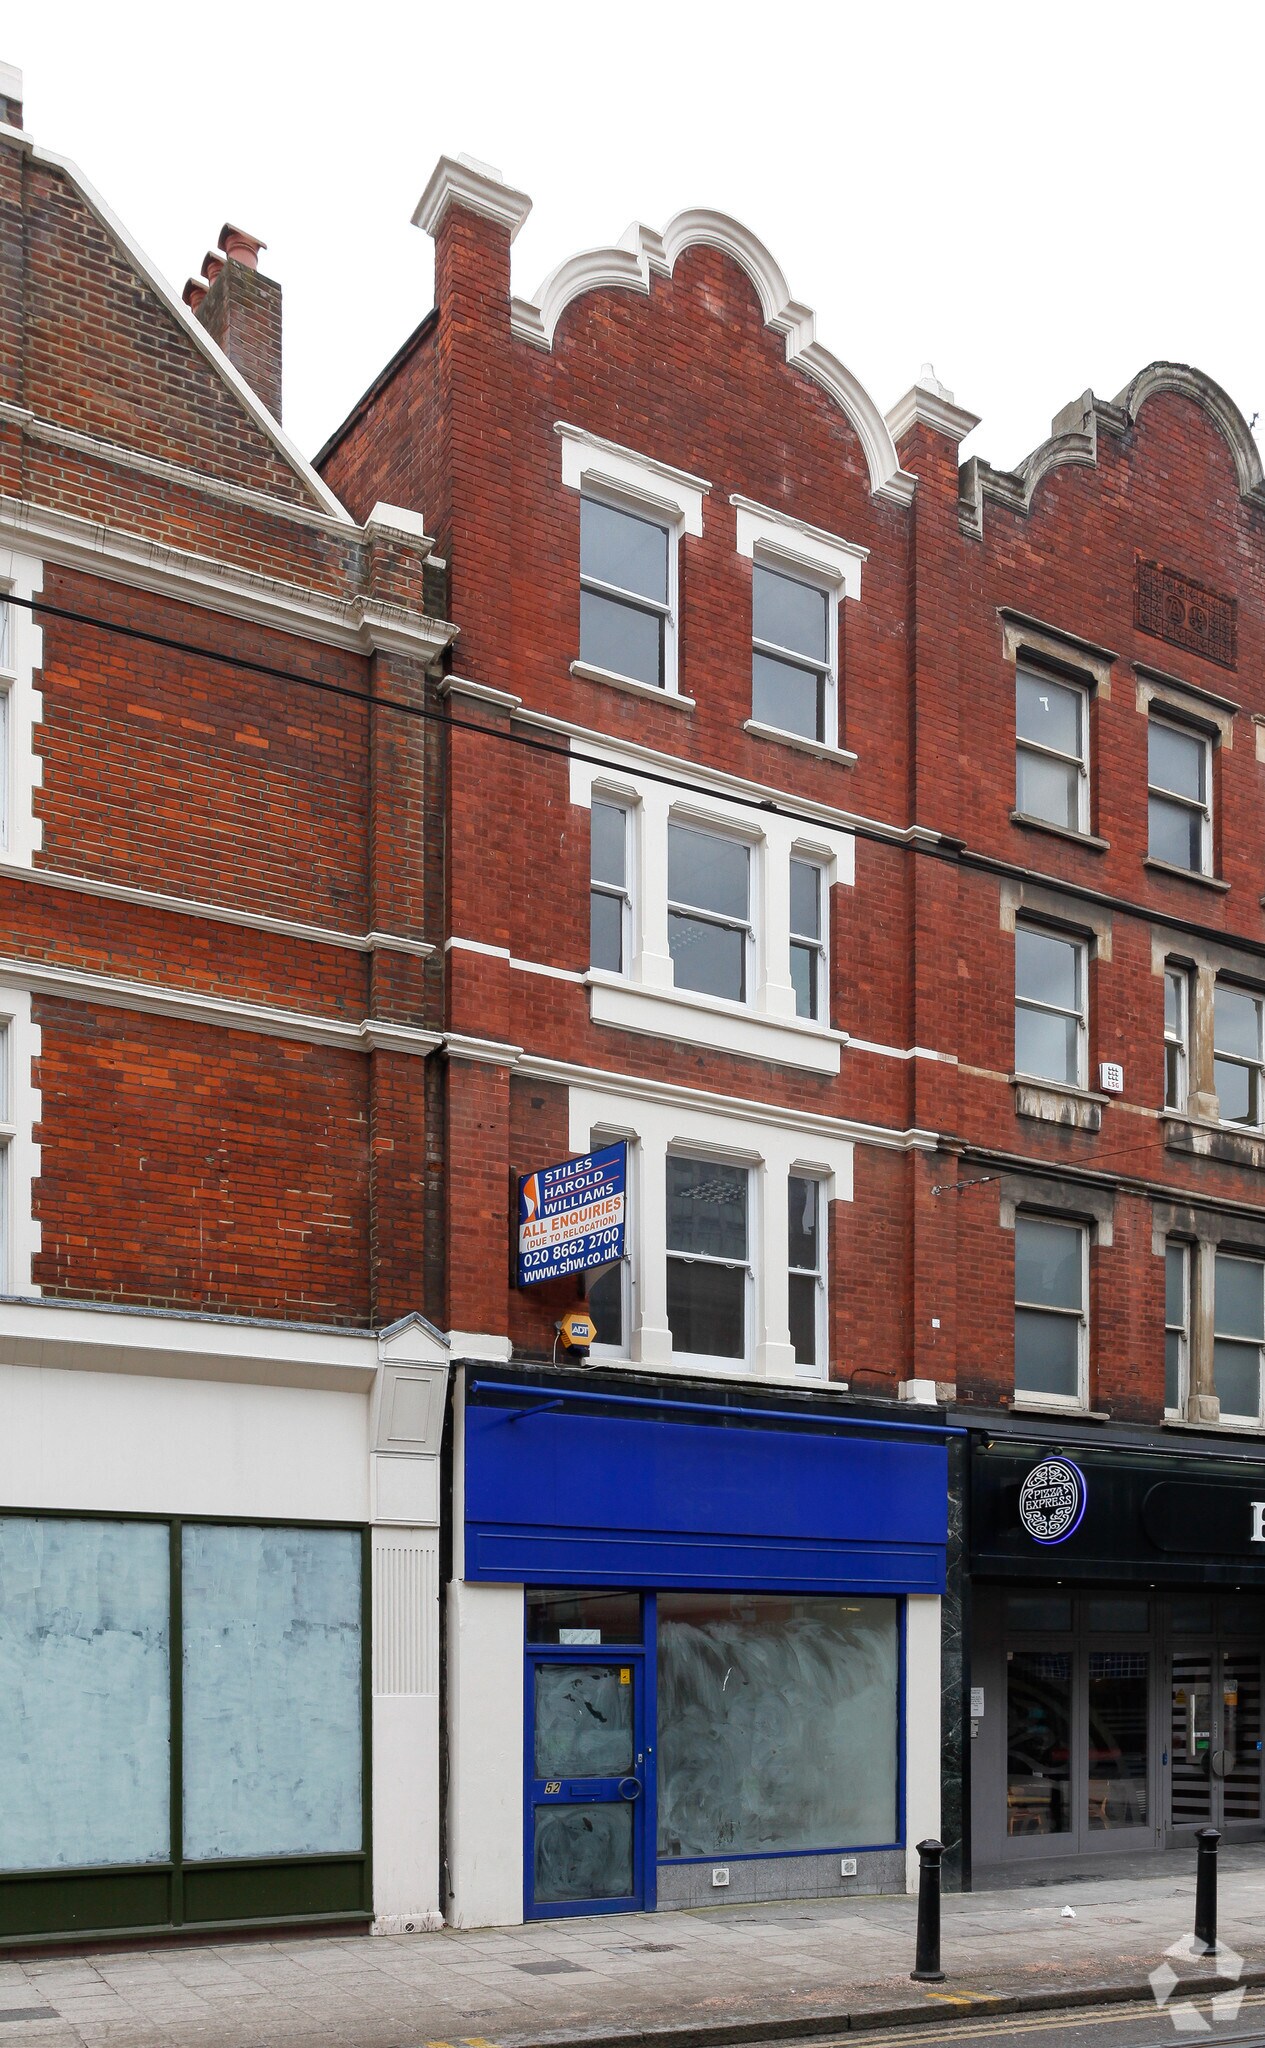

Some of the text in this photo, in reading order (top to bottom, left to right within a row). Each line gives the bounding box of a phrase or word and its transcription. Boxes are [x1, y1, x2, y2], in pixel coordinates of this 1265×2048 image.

[545, 1158, 592, 1183] STILES
[544, 1183, 613, 1215] WILLIAMS
[545, 1171, 603, 1200] HAROLD
[522, 1196, 621, 1239] ALL ENQUIRIES
[527, 1214, 617, 1250] (DUE TO RELOCATION)
[524, 1227, 619, 1267] 020 8662 2700
[524, 1243, 619, 1283] www.shw.co.uk
[571, 1325, 589, 1335] ADT
[1025, 1495, 1072, 1510] EXPRESS
[1034, 1487, 1063, 1499] PIZZA
[546, 1783, 560, 1793] 52
